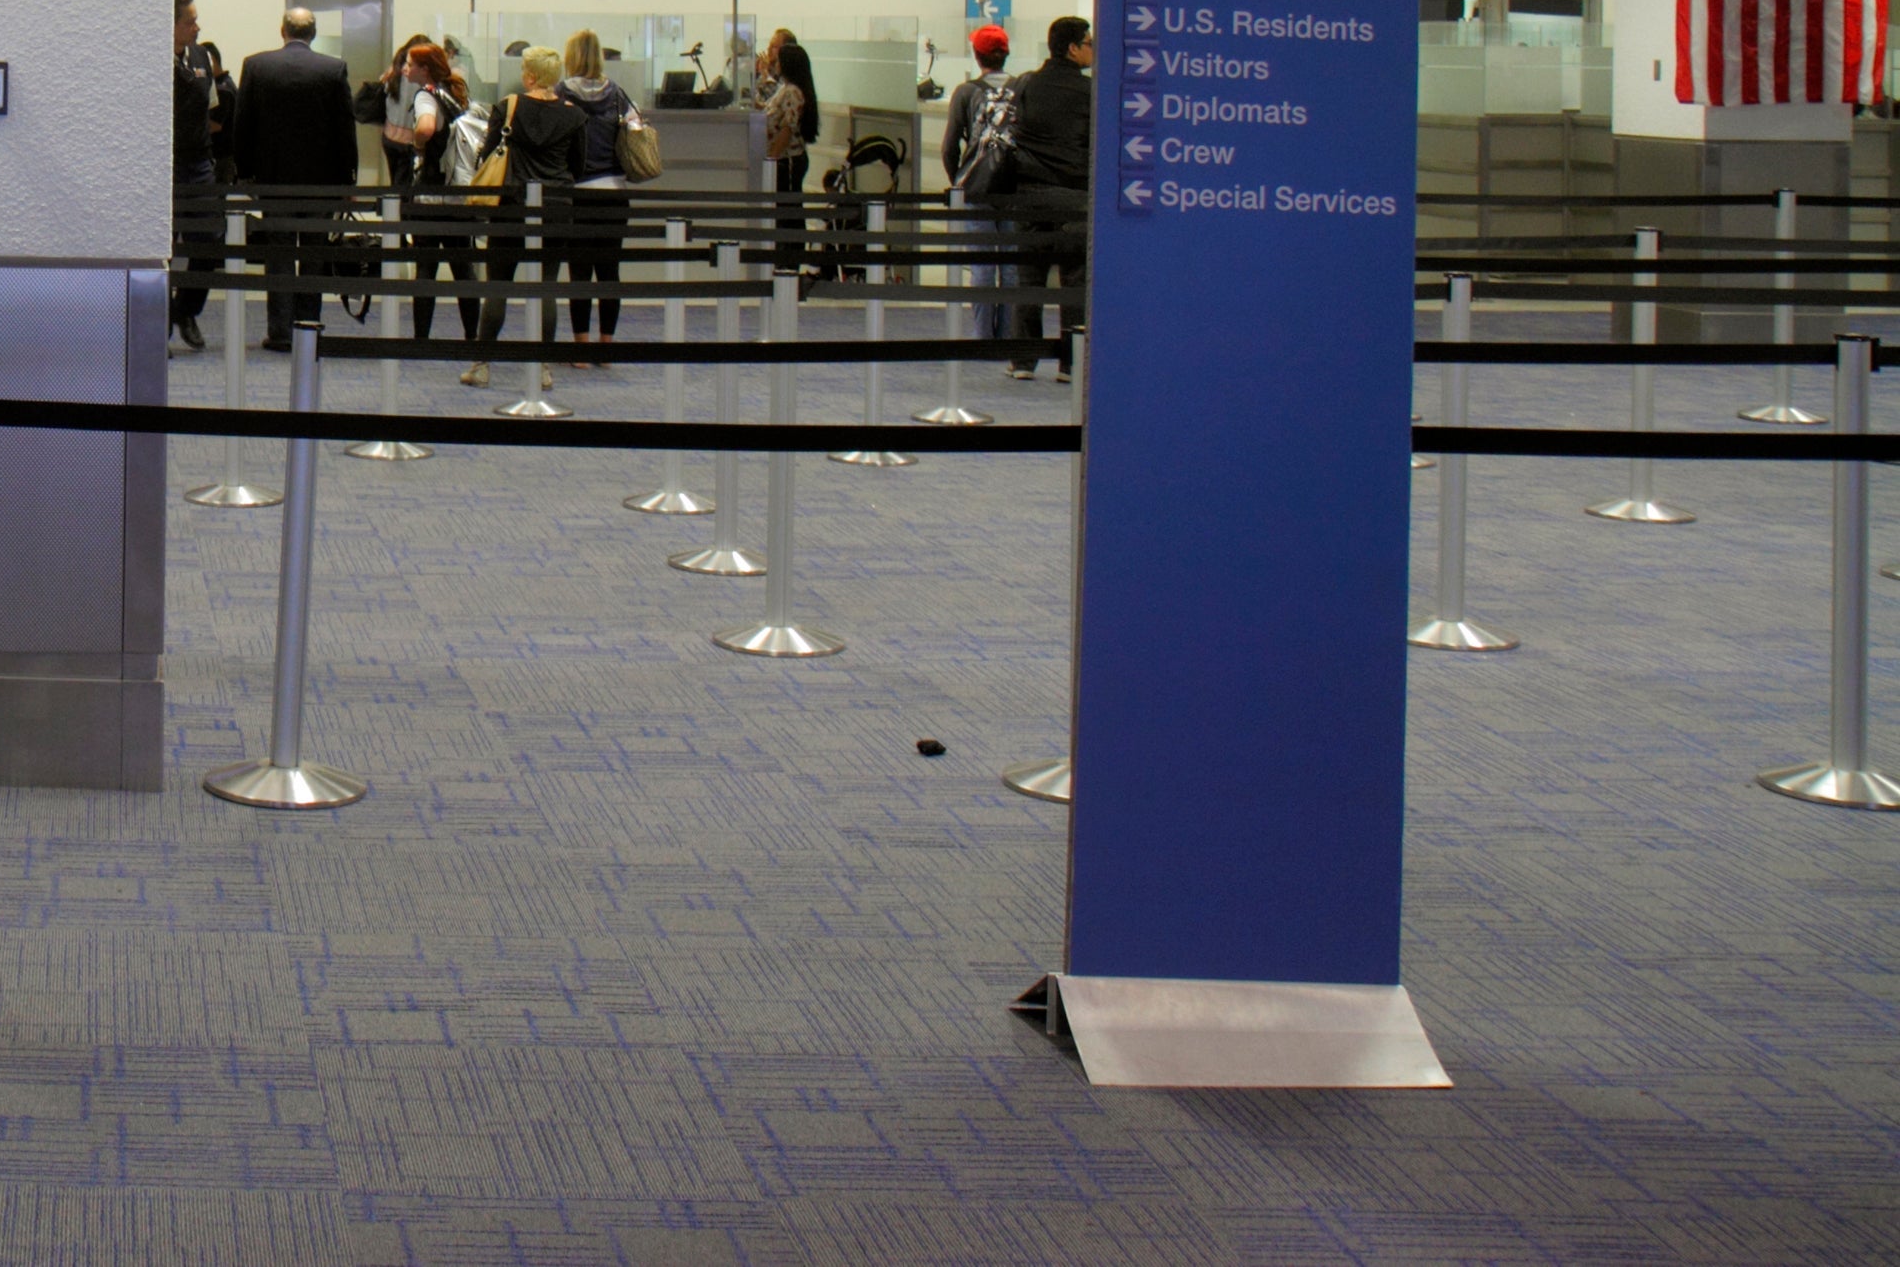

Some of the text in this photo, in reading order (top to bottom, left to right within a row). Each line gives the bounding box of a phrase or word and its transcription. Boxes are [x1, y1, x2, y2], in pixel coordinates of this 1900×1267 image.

[1163, 7, 1375, 43] U.S. Residents
[1161, 50, 1270, 81] Visitors
[1161, 94, 1308, 126] Diplomats
[1159, 137, 1235, 165] Crew
[1159, 181, 1397, 216] Special Services
